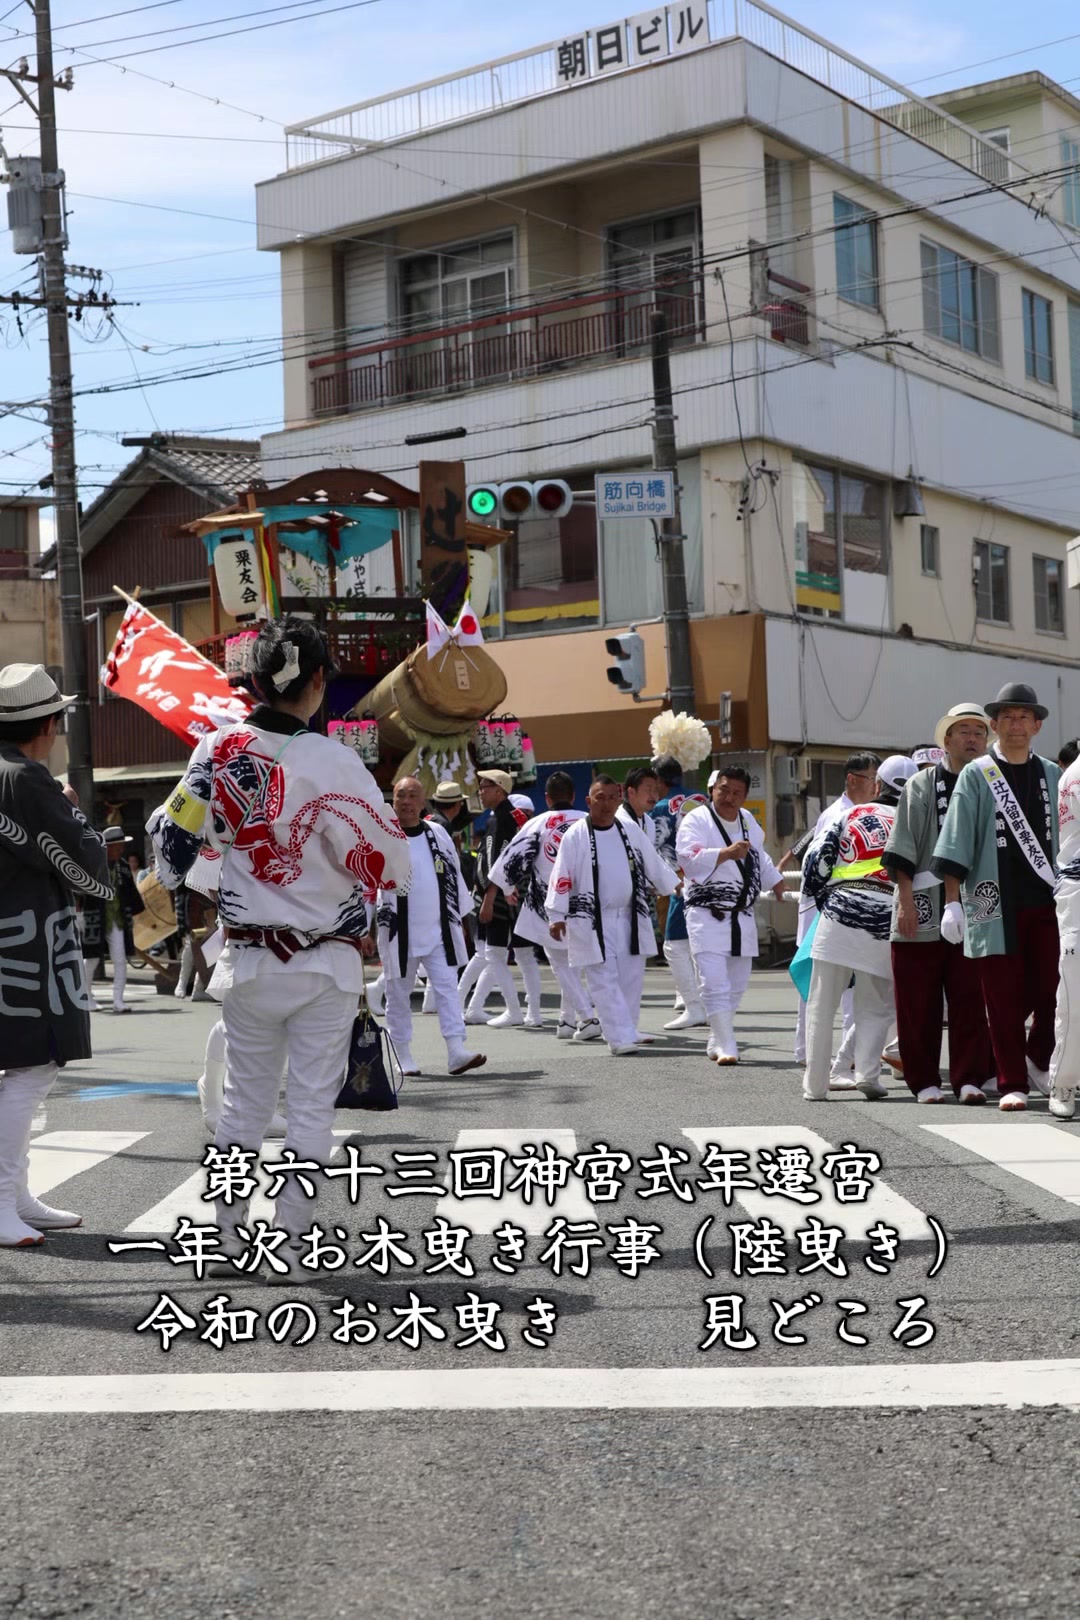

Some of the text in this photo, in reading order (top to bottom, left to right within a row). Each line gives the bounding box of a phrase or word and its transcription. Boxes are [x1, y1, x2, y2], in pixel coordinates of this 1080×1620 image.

[557, 6, 704, 81] 朝日ビル
[604, 480, 665, 500] 筋向橋
[604, 501, 667, 514] Sujikai Bridge
[170, 793, 186, 813] 部
